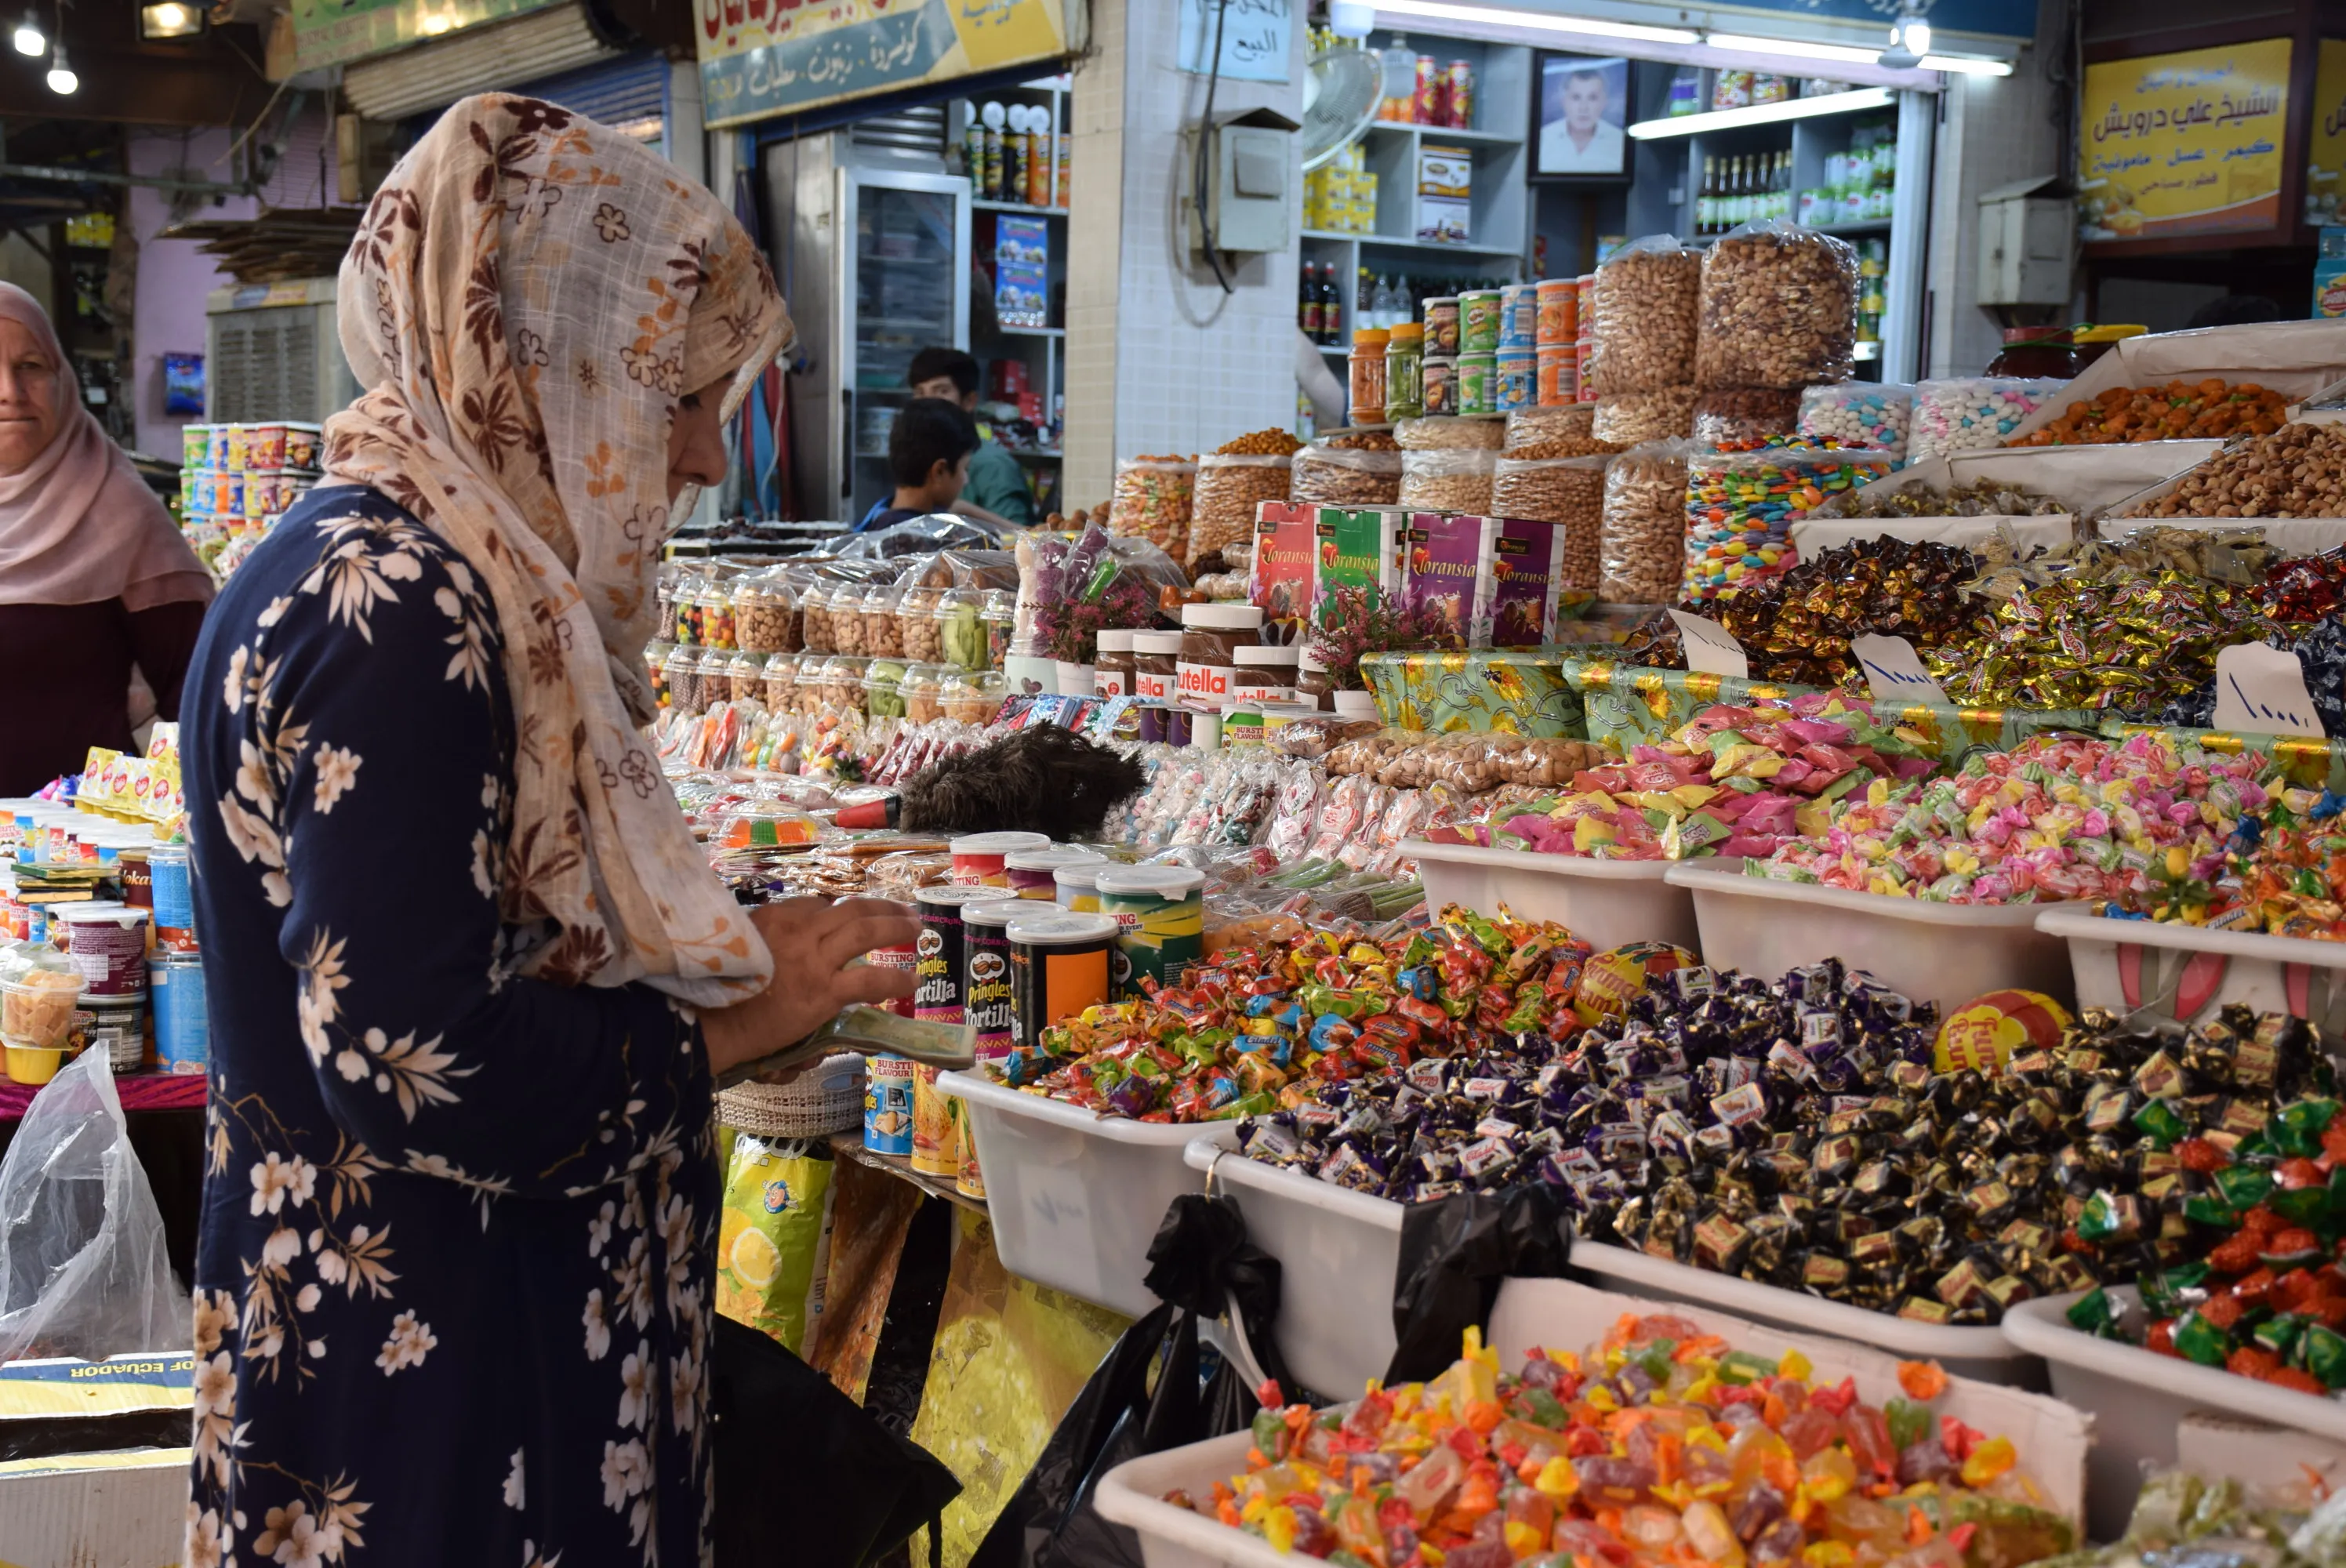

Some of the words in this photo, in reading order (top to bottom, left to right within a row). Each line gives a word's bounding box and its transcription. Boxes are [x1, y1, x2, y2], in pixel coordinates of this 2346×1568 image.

[1231, 28, 1278, 62] البيع
[2170, 98, 2213, 132] علي
[2215, 83, 2279, 128] الشيخ
[2092, 101, 2167, 143] درويش
[2166, 147, 2205, 167] عسل
[1136, 677, 1164, 697] tella
[1176, 668, 1226, 695] utella
[954, 875, 979, 887] STING
[940, 916, 964, 926] CRUNC
[870, 953, 913, 962] BURSTING
[914, 978, 956, 1005] ortilla
[968, 979, 1011, 1008] Pringles
[1244, 1035, 1280, 1045] Citadel
[874, 1067, 910, 1077] FLAVOUR
[877, 1059, 913, 1070] BURSTI
[71, 1363, 164, 1378] ECUADOR
[169, 1361, 194, 1372] OF
